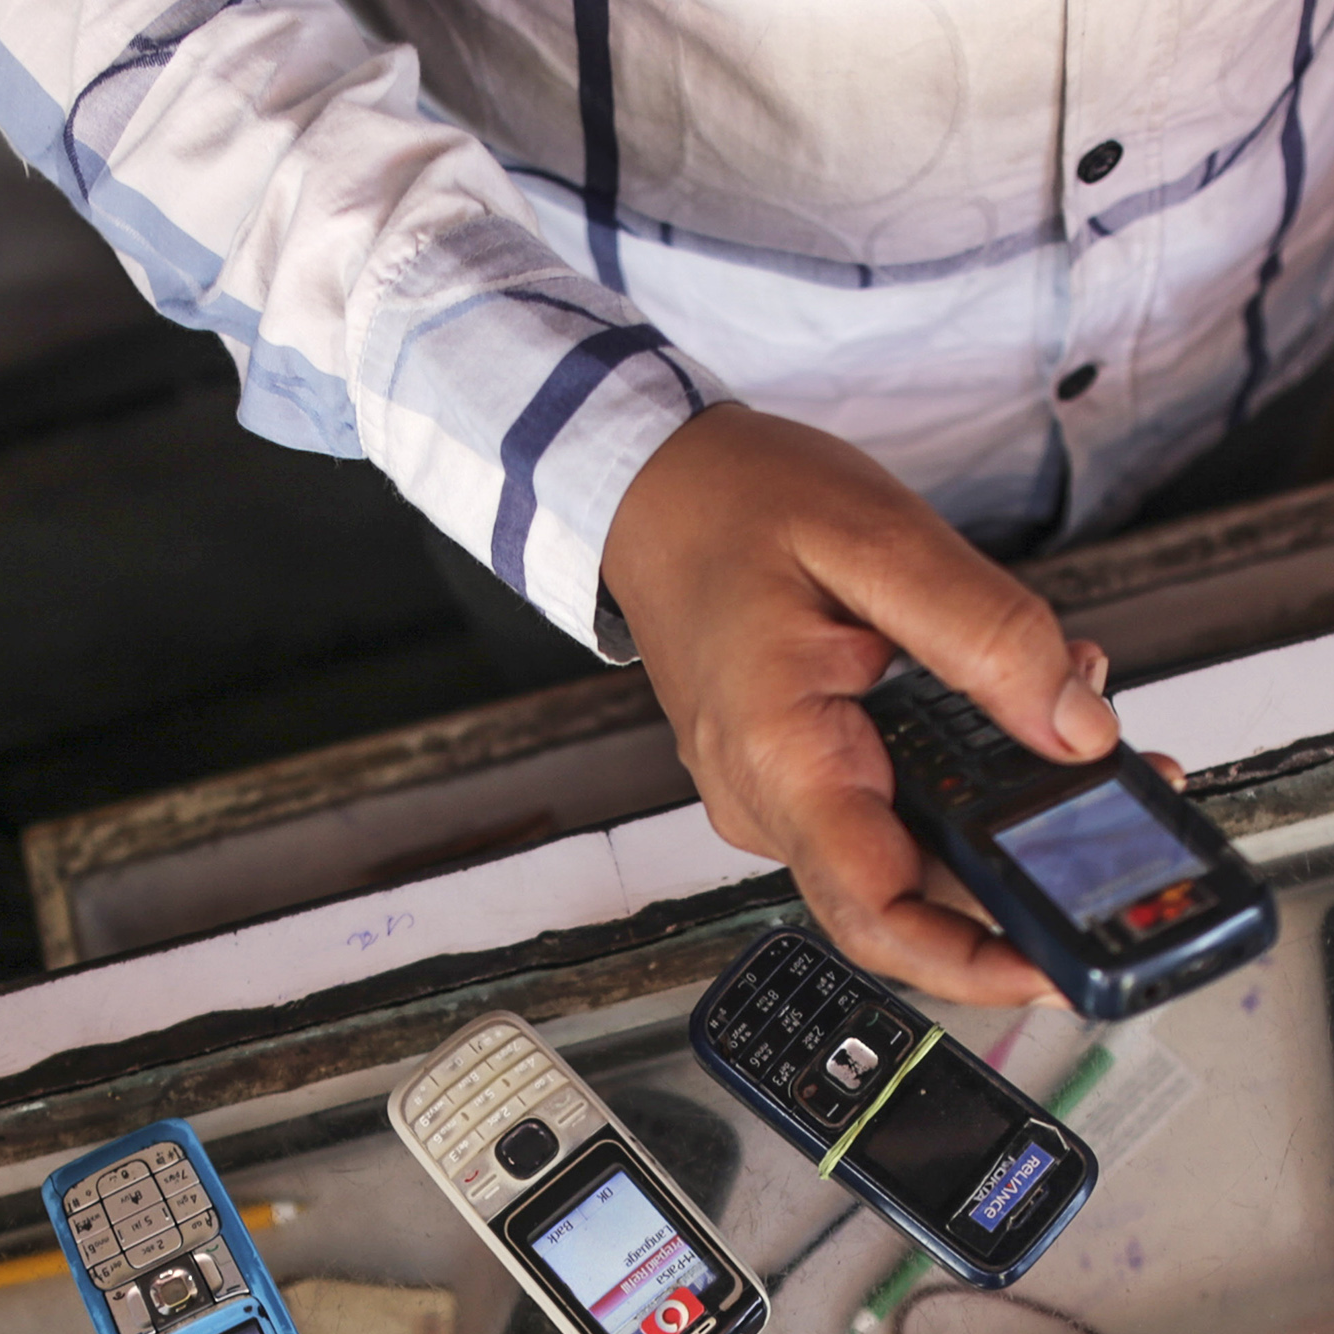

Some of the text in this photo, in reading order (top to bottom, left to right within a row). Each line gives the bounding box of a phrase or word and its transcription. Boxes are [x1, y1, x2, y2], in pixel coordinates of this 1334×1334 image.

[596, 1186, 614, 1204] OK
[973, 1154, 1016, 1204] NOKIA
[546, 1219, 573, 1245] Back
[621, 1222, 674, 1268] Language
[643, 1234, 685, 1273] Prepaid
[655, 1249, 696, 1285] M-Paisa
[619, 1266, 648, 1294] Refill
